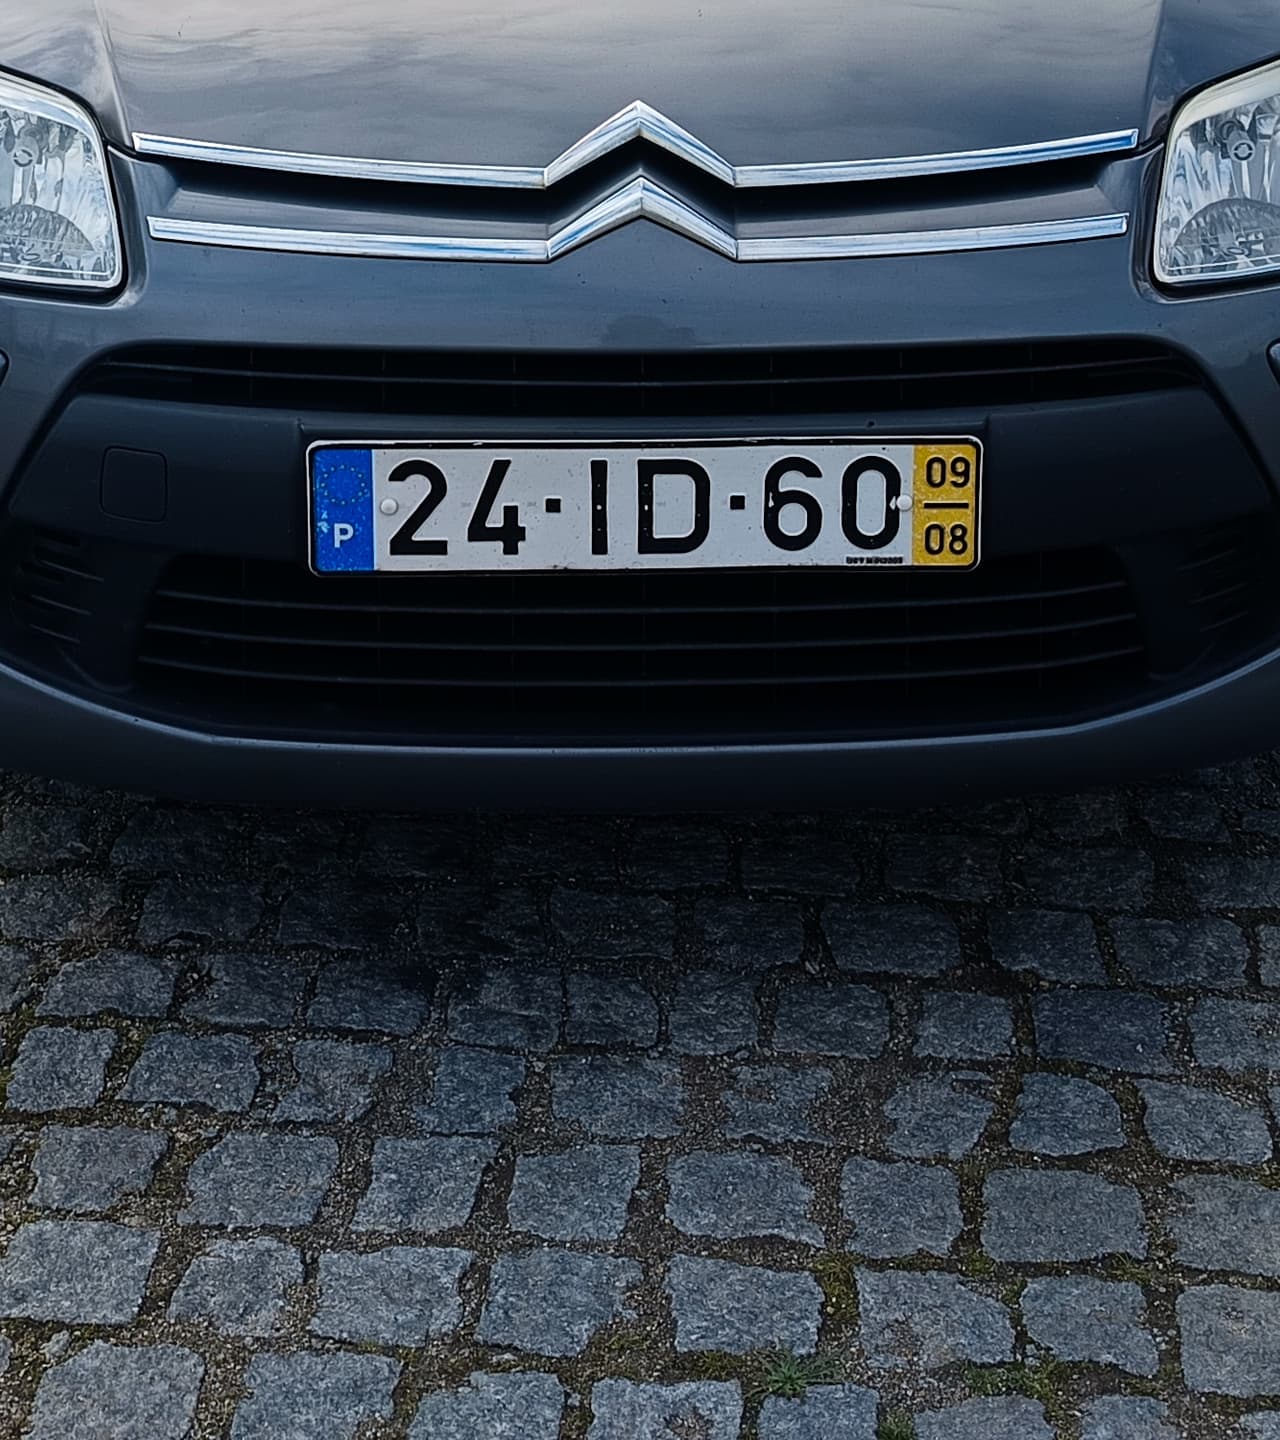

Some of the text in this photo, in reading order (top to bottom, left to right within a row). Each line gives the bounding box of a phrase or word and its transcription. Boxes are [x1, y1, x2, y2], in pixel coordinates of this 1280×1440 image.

[926, 456, 971, 488] 09
[334, 523, 354, 548] P
[925, 523, 968, 556] 08
